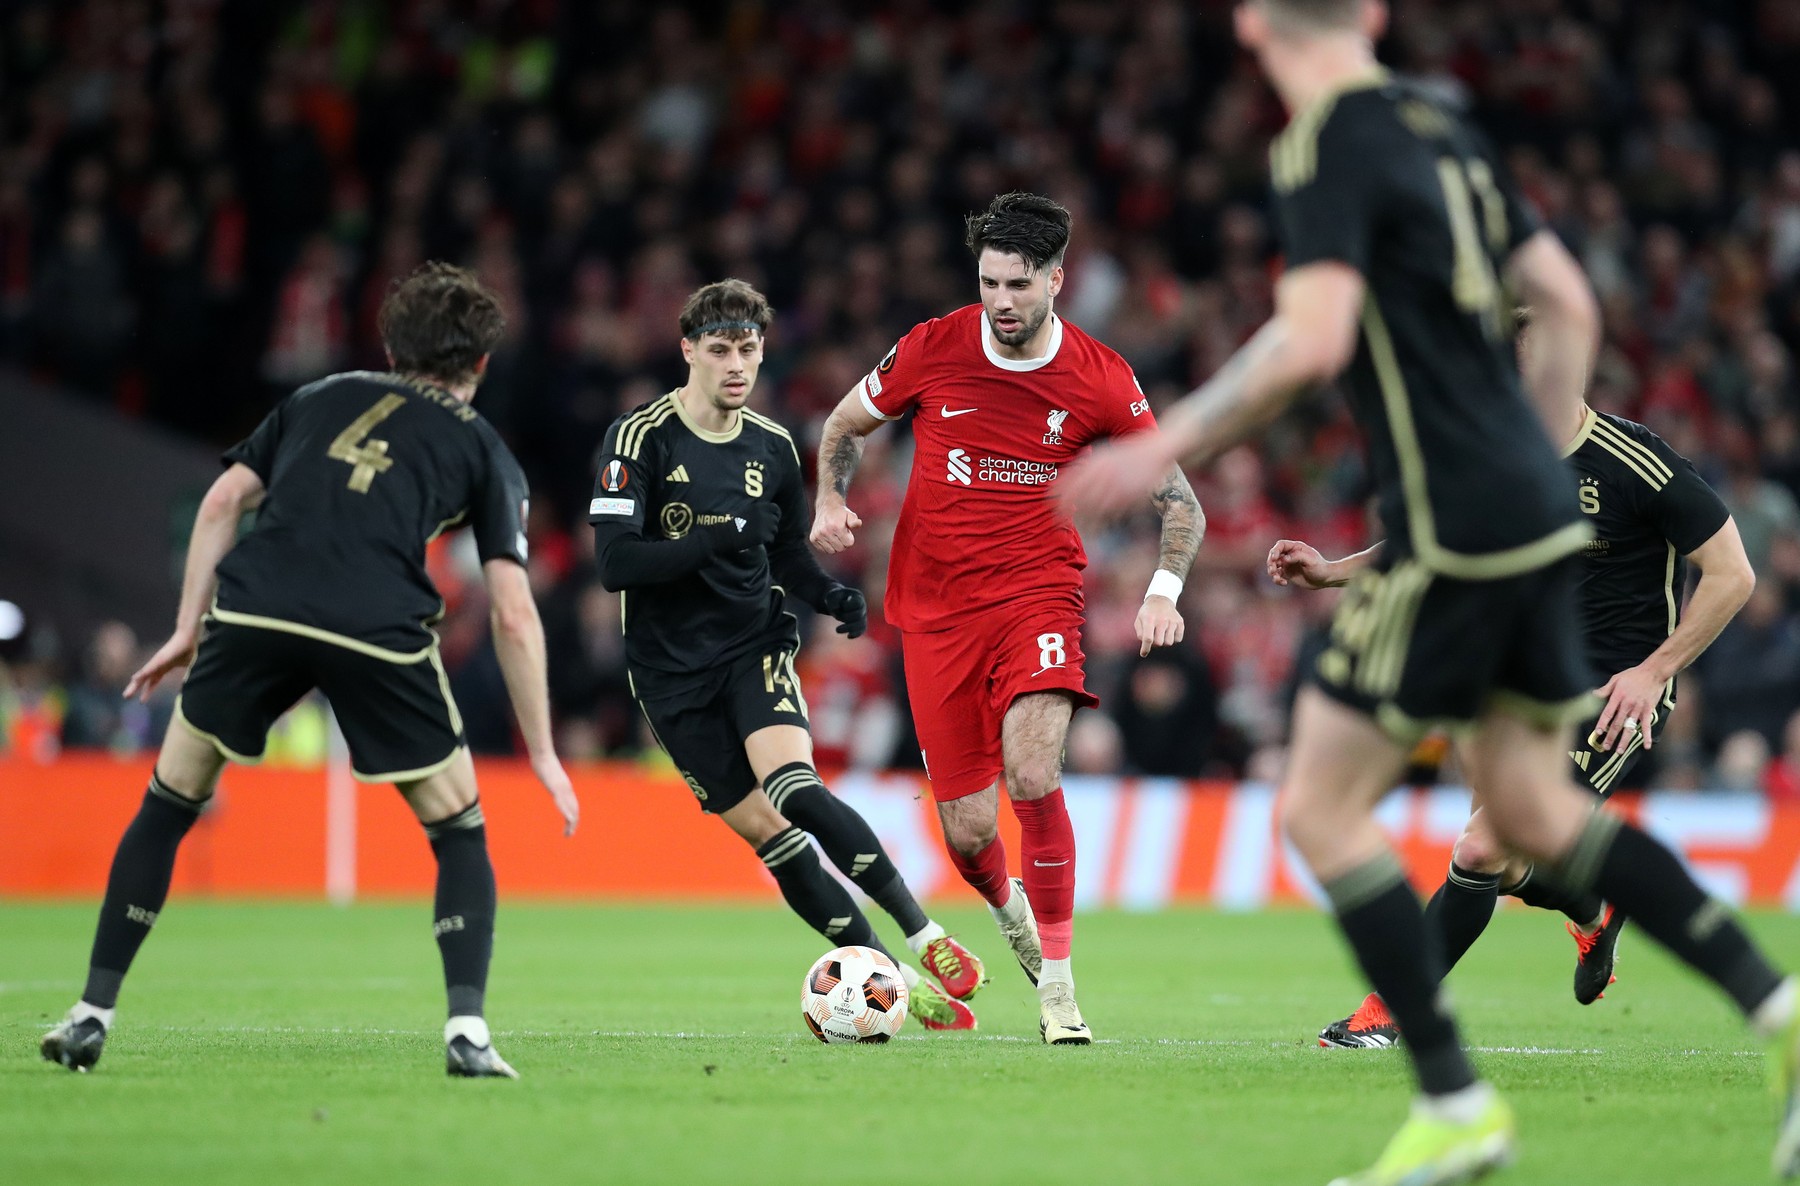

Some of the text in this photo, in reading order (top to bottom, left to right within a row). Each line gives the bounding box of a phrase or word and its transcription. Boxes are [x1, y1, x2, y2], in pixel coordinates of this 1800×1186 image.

[326, 392, 407, 495] 4
[978, 467, 1058, 485] chartered
[979, 456, 1055, 473] standard
[1579, 485, 1600, 514] S
[1031, 632, 1066, 677] 8
[763, 651, 793, 695] 14
[833, 1005, 855, 1015] EUROPA
[824, 1028, 857, 1041] molten
